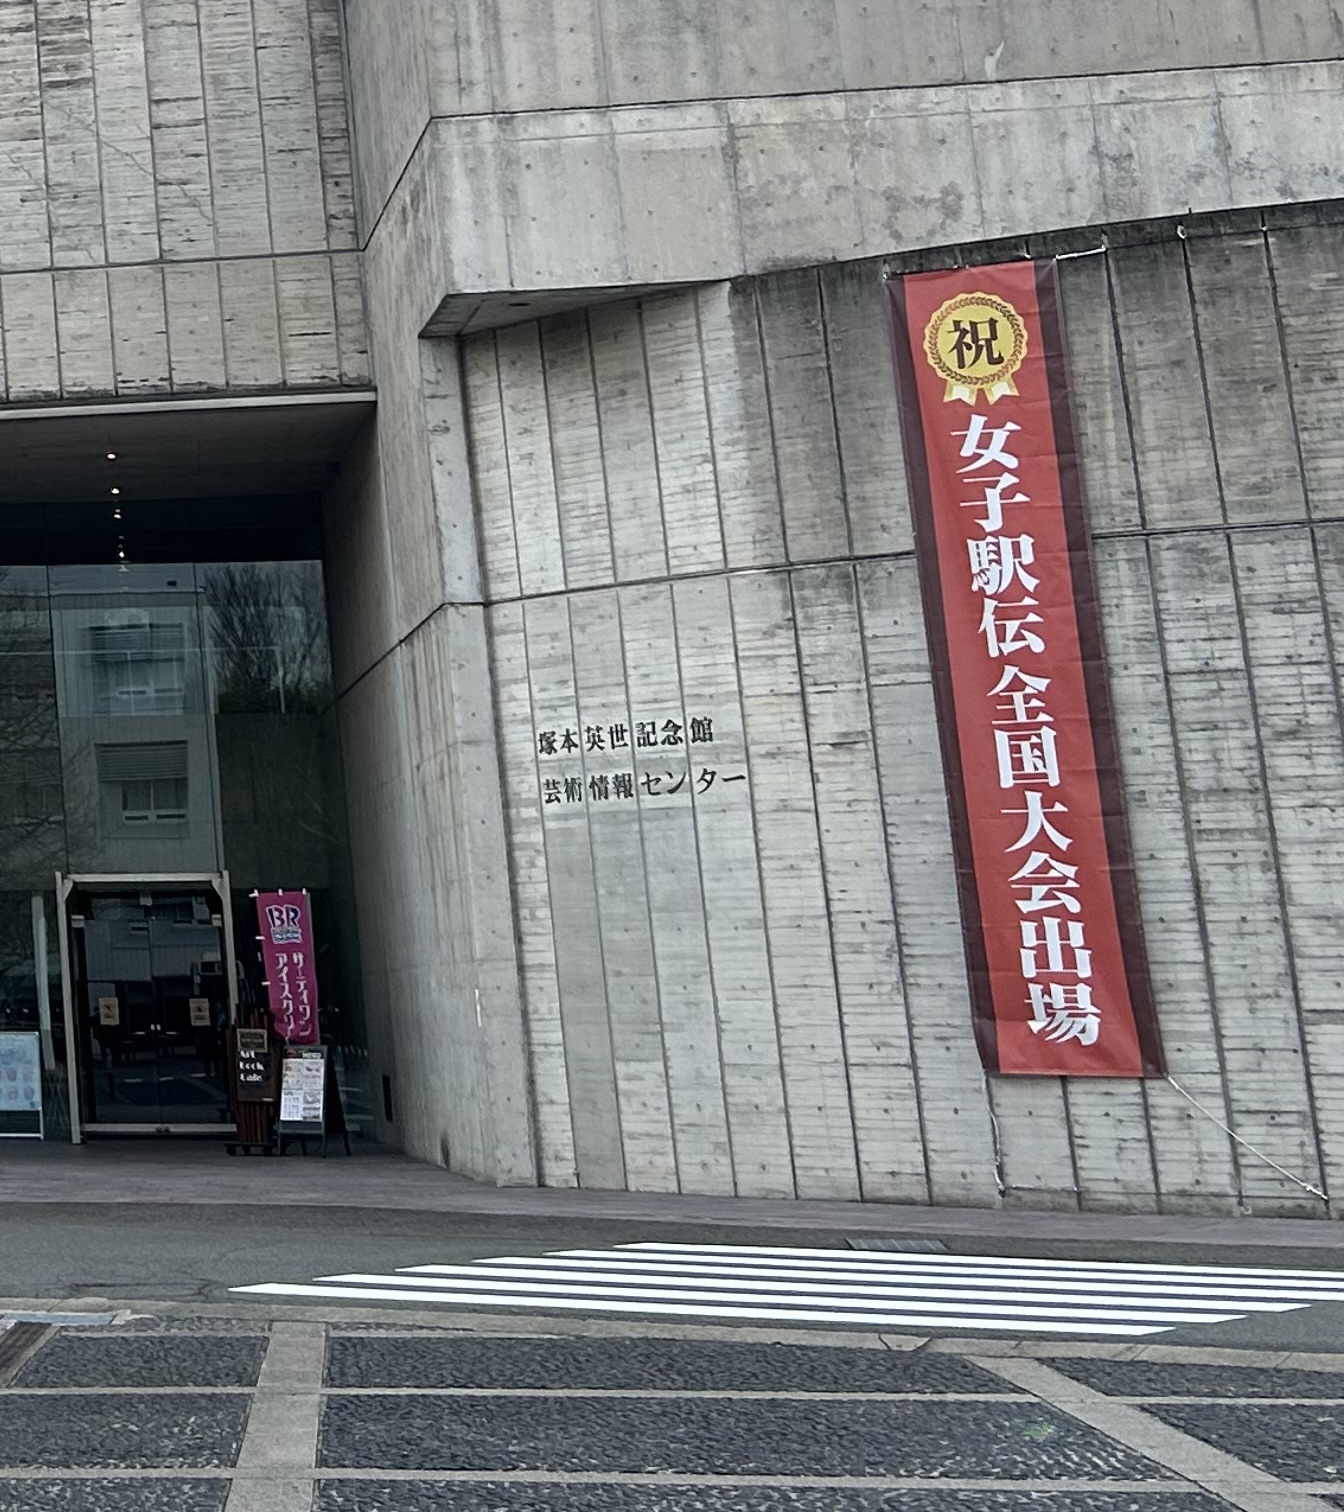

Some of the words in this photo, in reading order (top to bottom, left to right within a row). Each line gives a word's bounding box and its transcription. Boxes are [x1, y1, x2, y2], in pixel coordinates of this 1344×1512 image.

[946, 317, 1005, 369] 祝
[538, 716, 714, 756] 塚本英世記念館
[949, 413, 1102, 1047] 女子駅伝全国大会出場
[543, 767, 747, 805] 芸術情報センター
[267, 906, 300, 928] BR
